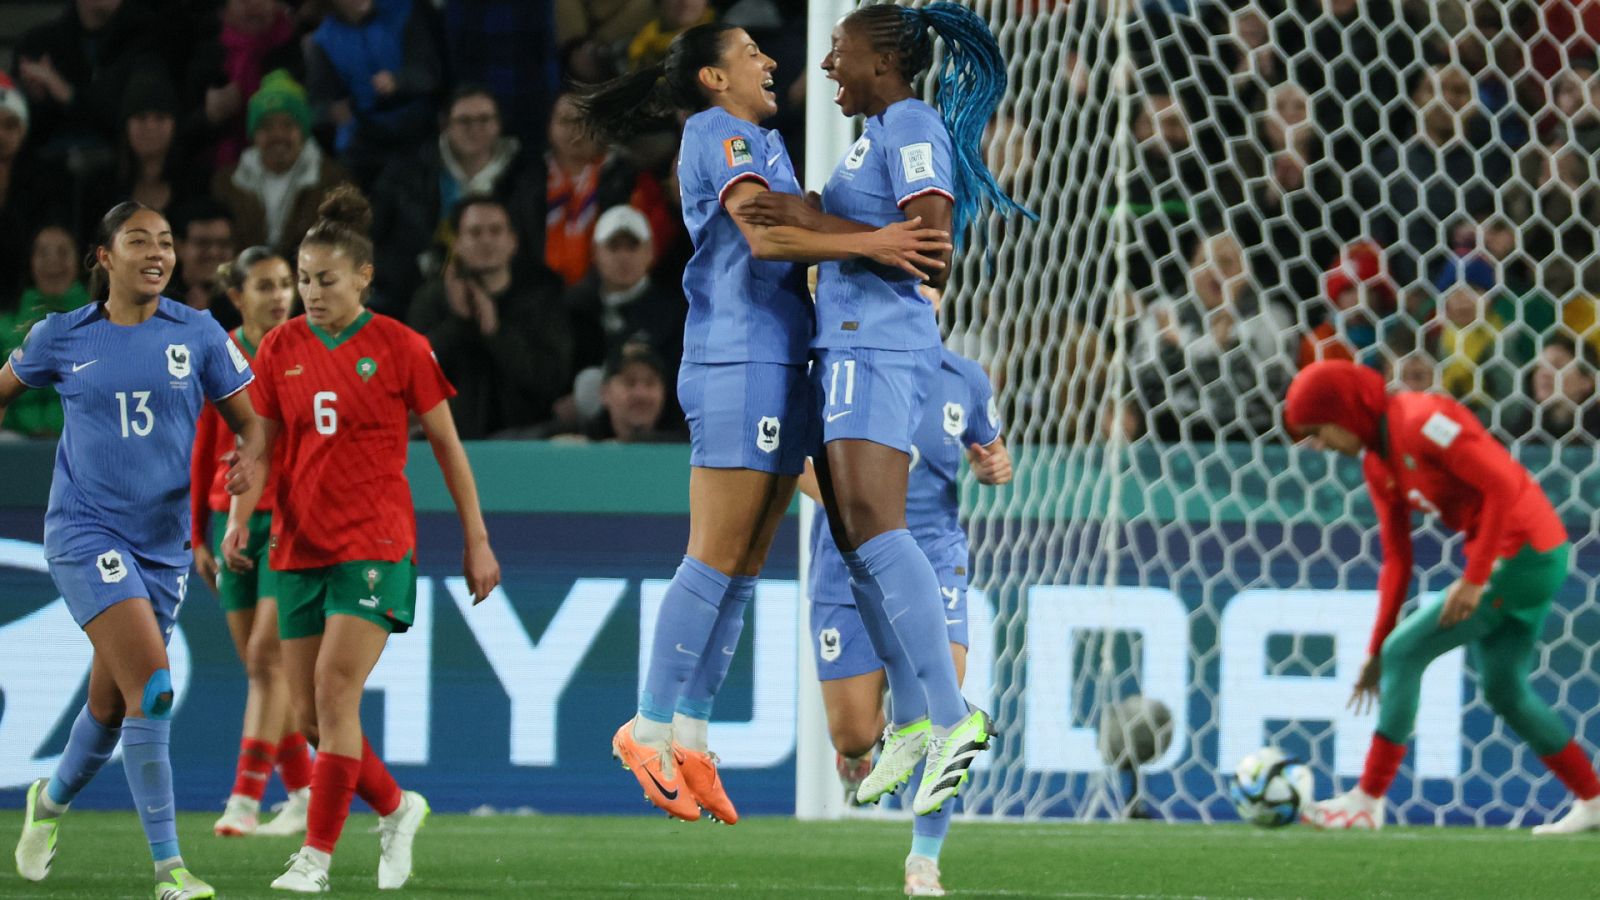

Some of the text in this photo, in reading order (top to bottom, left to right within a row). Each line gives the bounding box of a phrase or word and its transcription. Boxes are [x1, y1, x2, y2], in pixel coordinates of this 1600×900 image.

[830, 360, 855, 406] 11
[115, 391, 154, 438] 13
[313, 391, 337, 435] 6
[275, 574, 1464, 780] YUDAI
